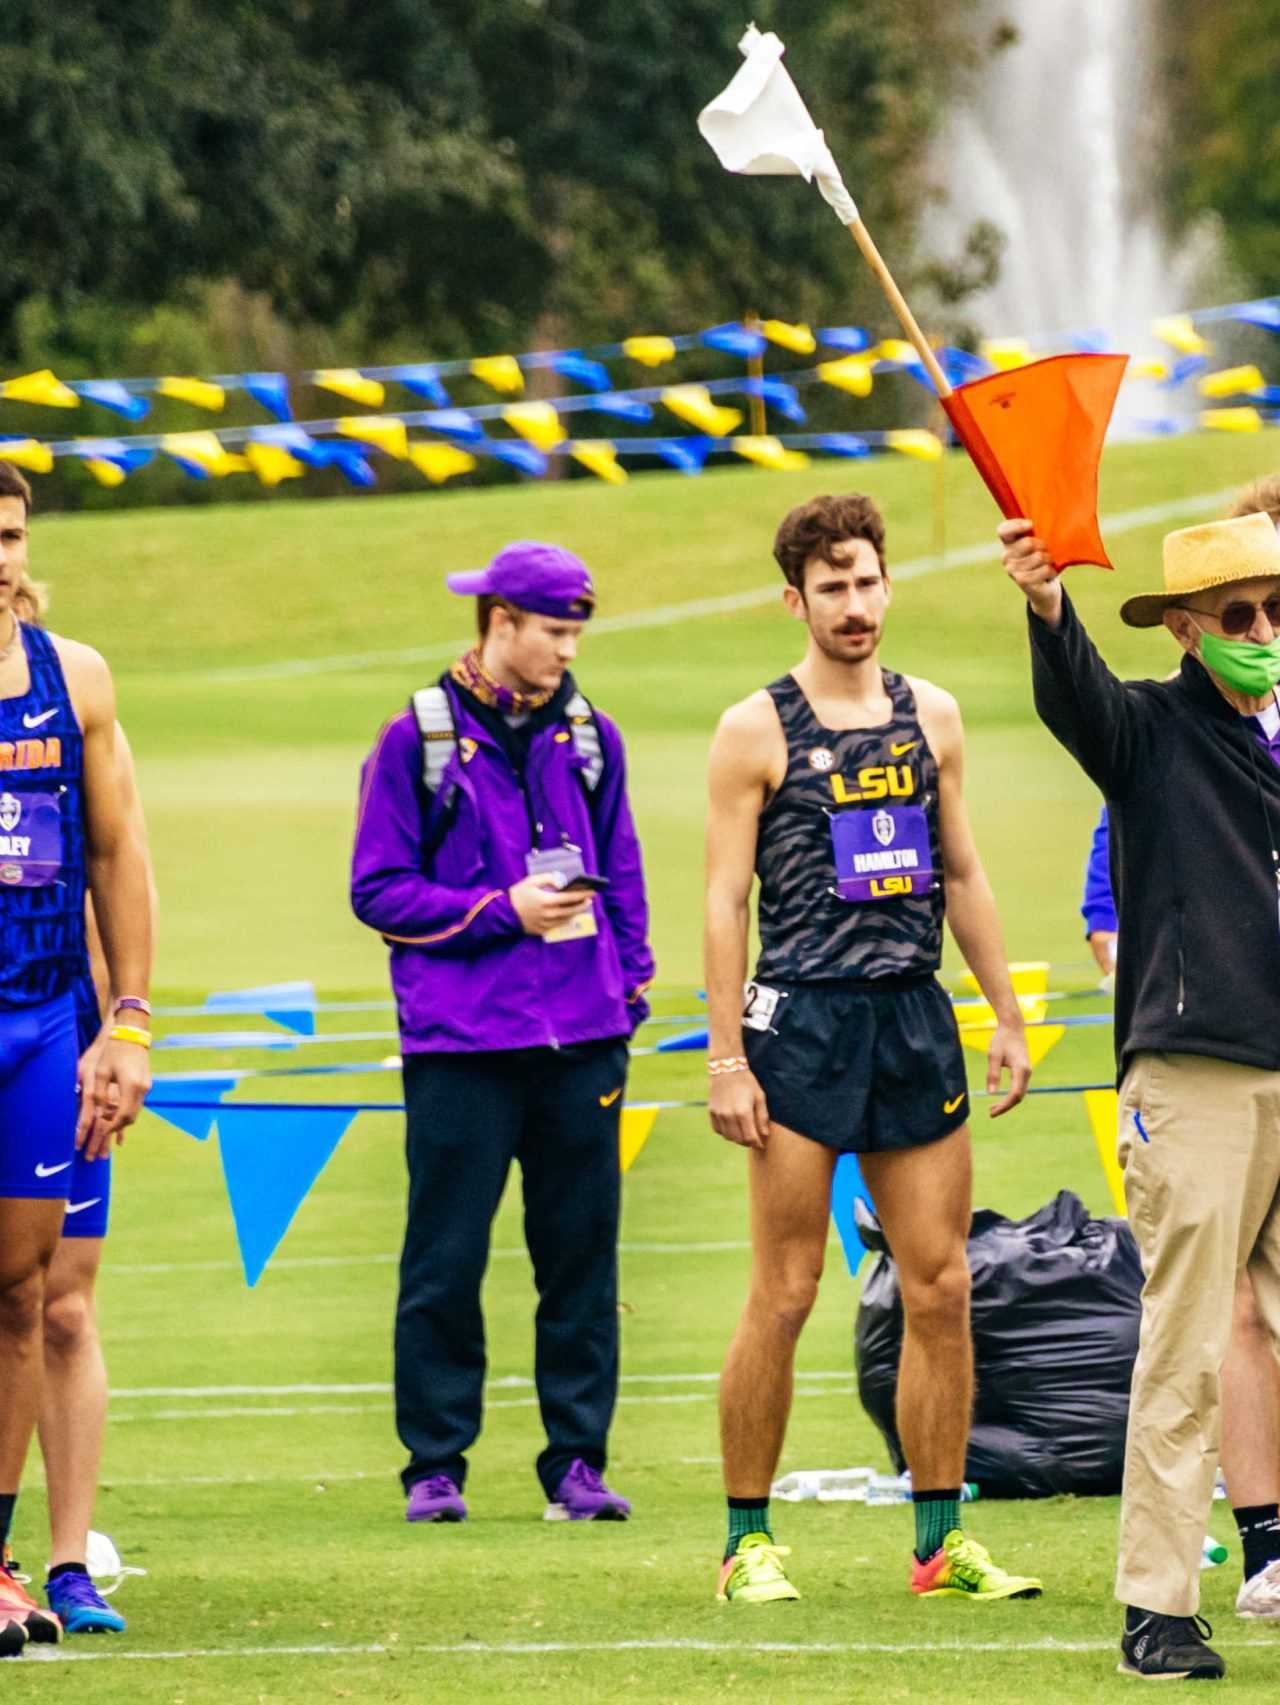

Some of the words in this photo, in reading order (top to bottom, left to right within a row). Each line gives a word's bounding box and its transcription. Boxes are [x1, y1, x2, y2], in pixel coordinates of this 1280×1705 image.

[830, 766, 914, 804] LSU
[853, 848, 919, 873] HAMILTON
[870, 876, 912, 897] LSU
